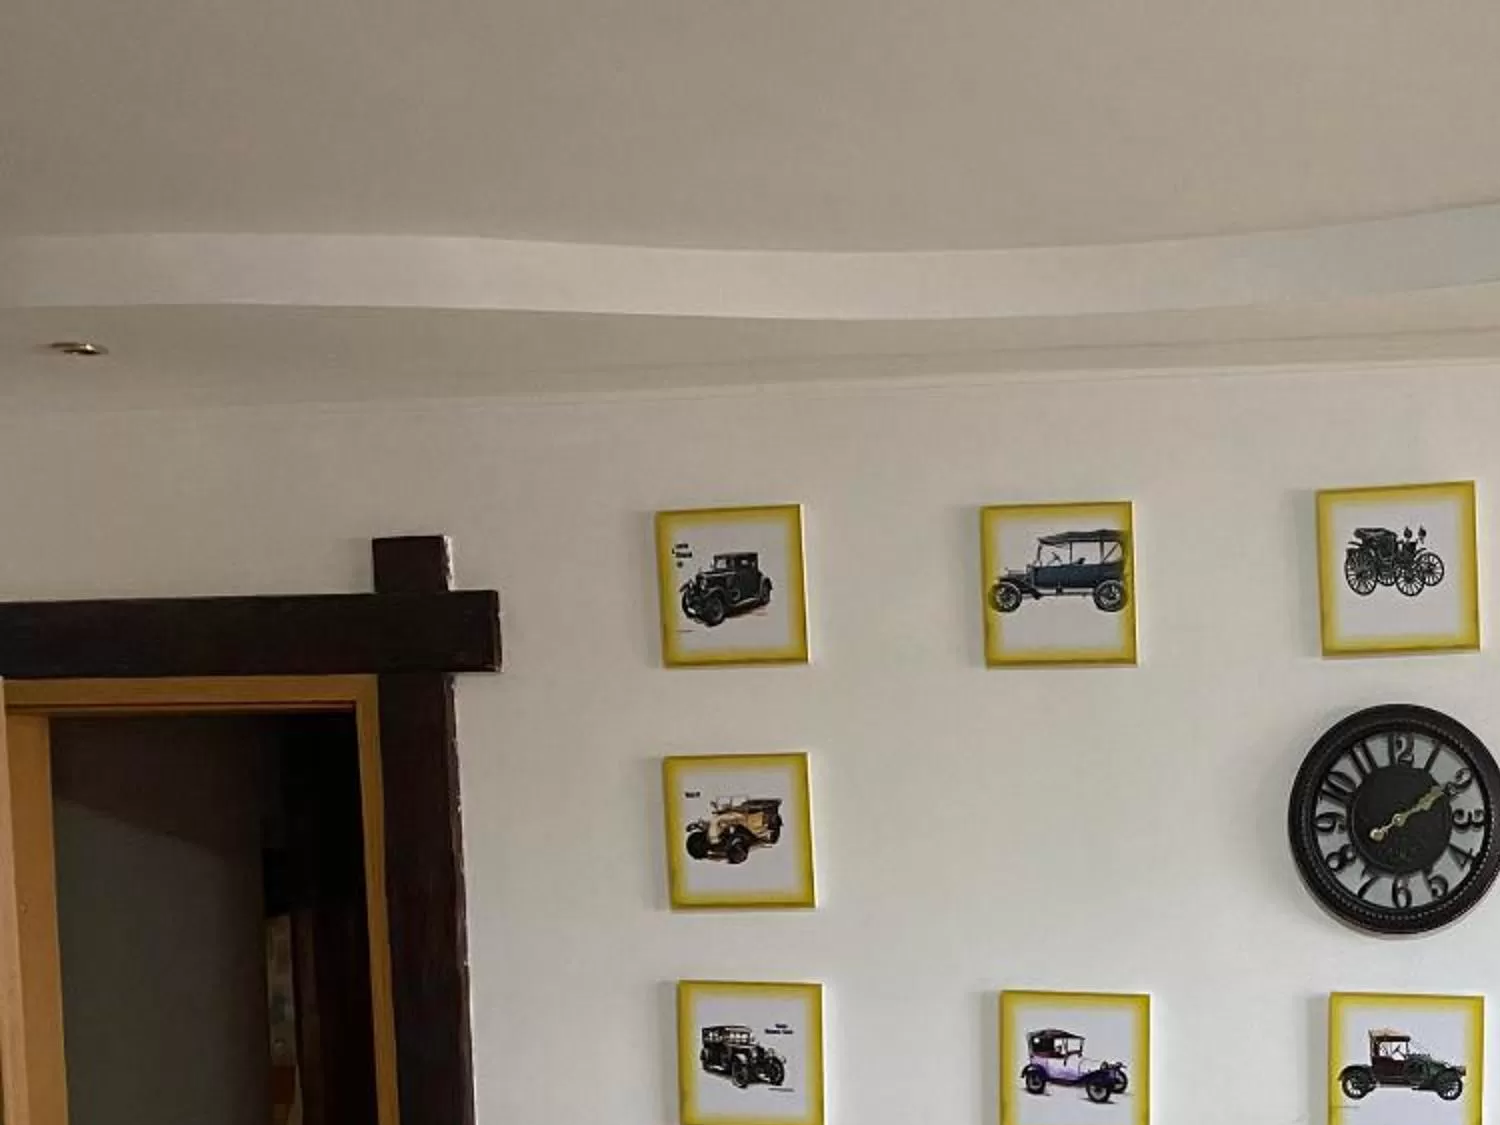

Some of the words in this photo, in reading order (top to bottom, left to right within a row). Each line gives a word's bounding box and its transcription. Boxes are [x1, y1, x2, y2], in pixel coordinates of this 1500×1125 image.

[1349, 738, 1375, 777] 11
[1388, 733, 1414, 766] 12
[1320, 771, 1358, 803] 10
[1443, 767, 1472, 797] 2
[1315, 812, 1347, 832] 9
[1453, 808, 1484, 827] 3
[1326, 844, 1356, 870] 8
[1448, 844, 1477, 869] 4
[1392, 873, 1412, 908] 6
